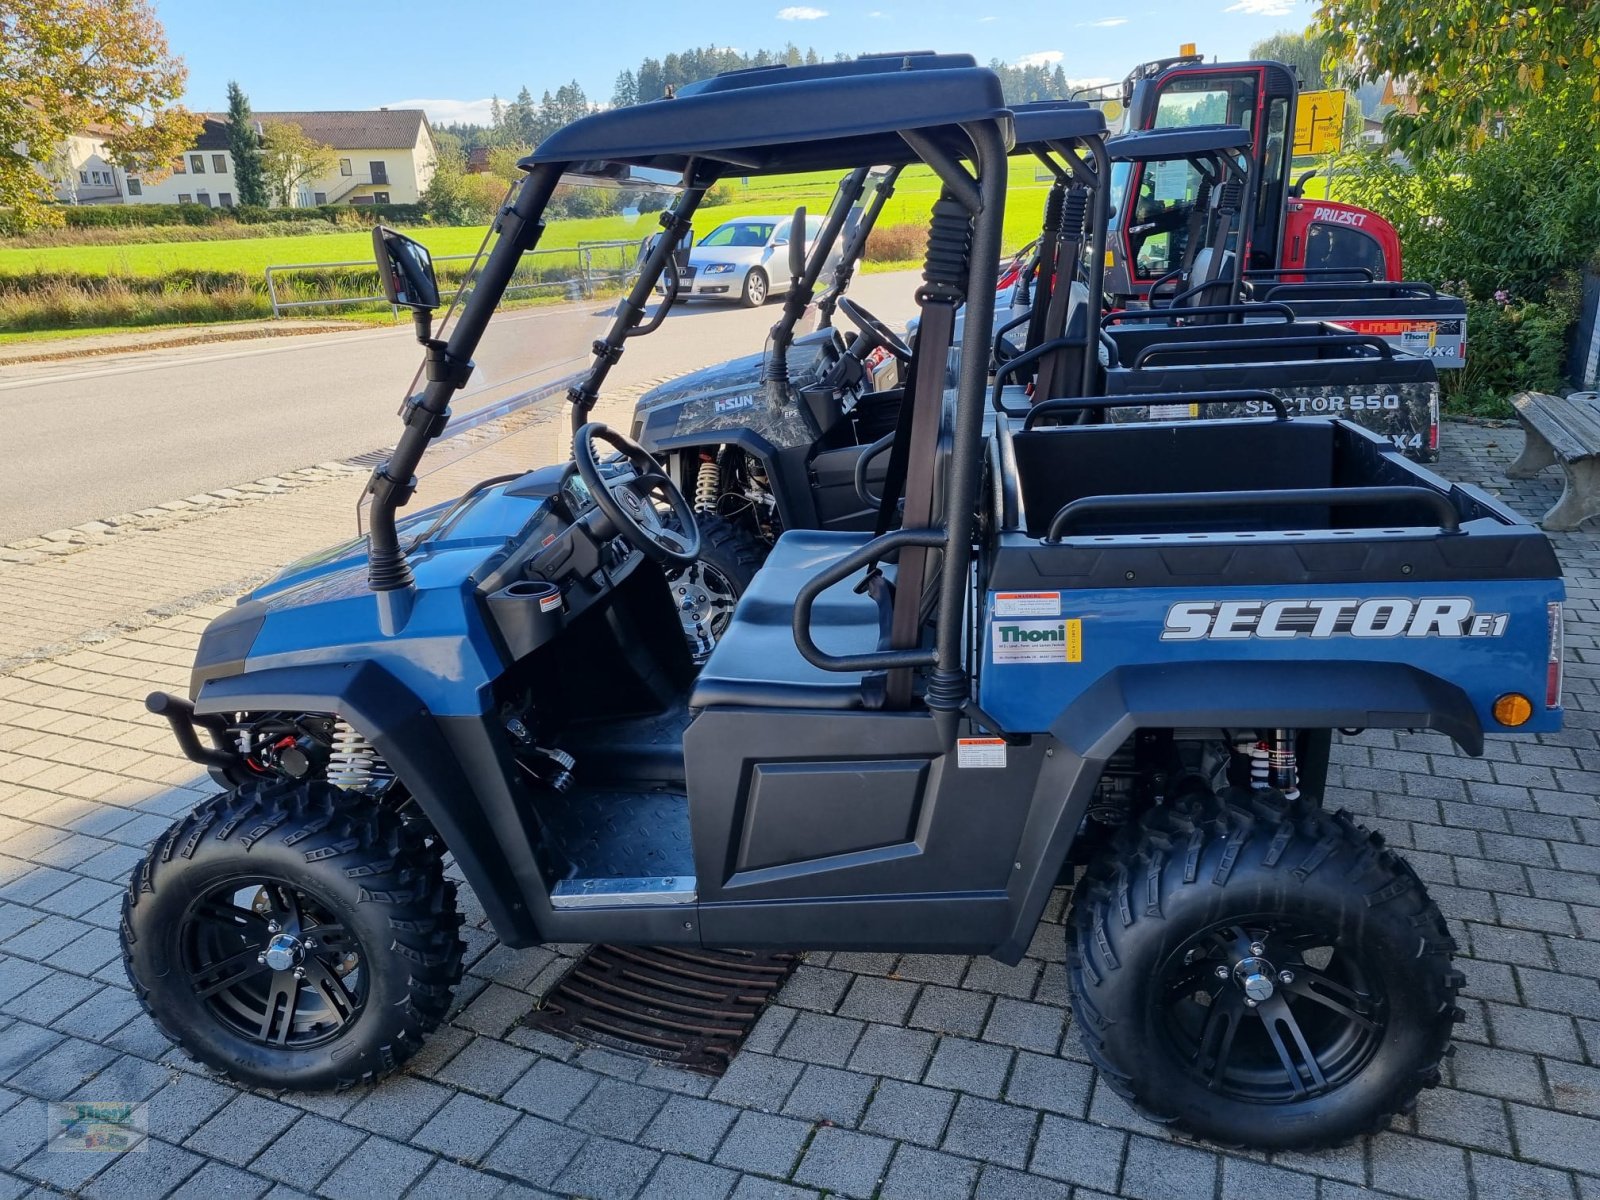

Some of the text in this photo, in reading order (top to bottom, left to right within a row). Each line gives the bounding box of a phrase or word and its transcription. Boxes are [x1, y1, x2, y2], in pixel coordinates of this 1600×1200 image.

[1350, 394, 1399, 409] 550
[1161, 598, 1508, 640] SECTOR E1
[998, 624, 1065, 642] Thoni
